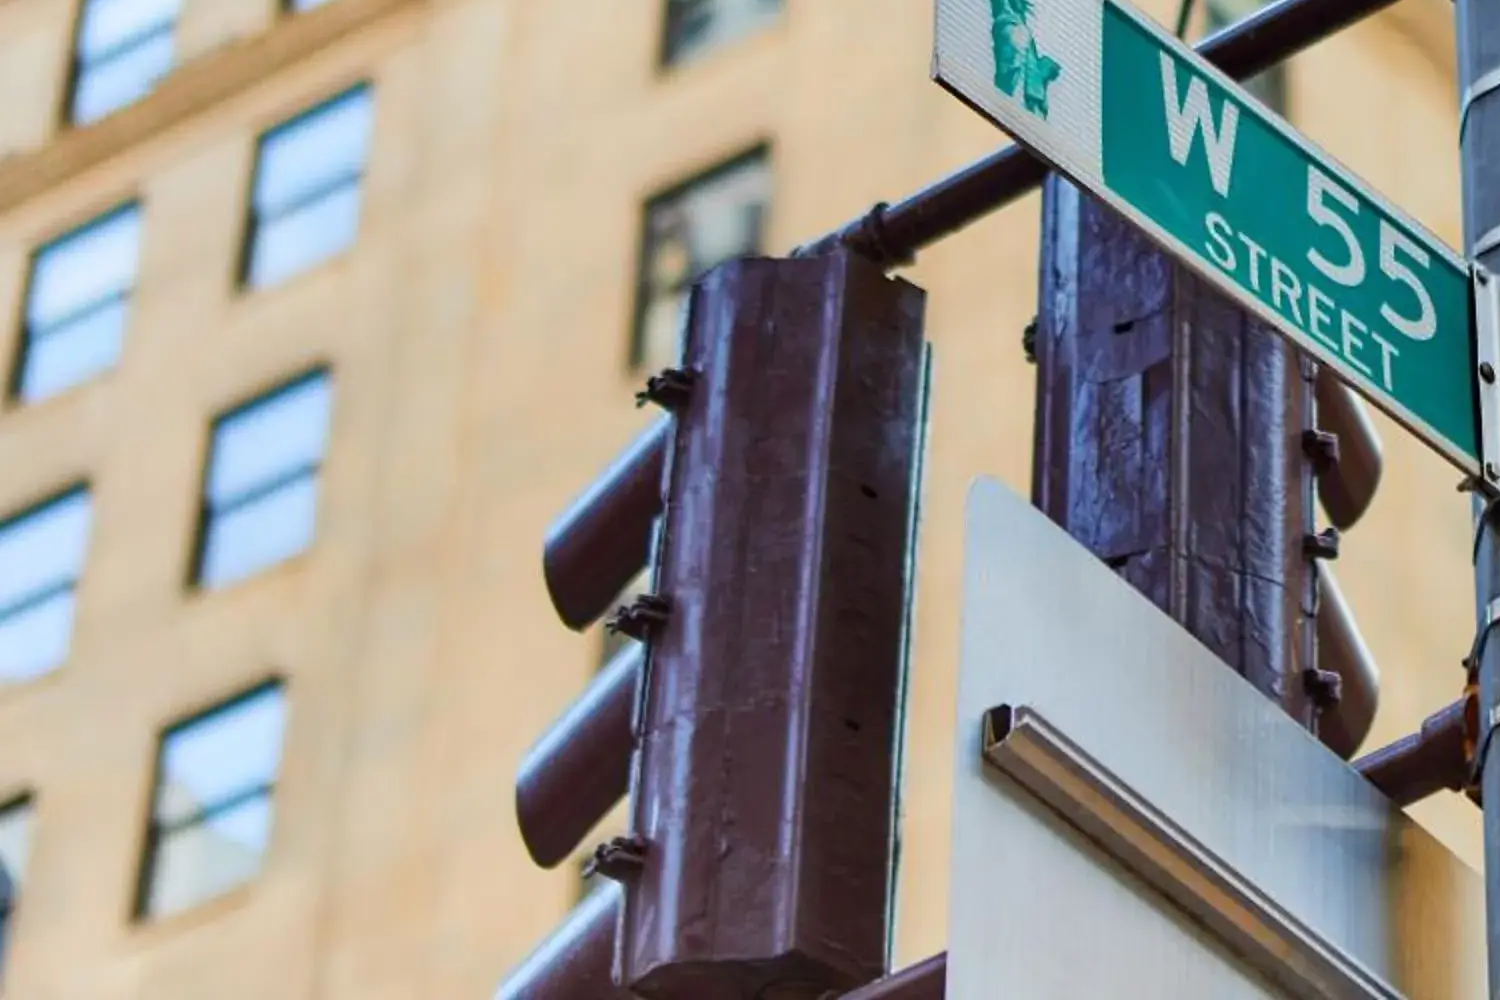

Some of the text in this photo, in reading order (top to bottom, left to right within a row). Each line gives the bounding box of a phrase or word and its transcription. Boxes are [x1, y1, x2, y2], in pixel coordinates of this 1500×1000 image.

[1160, 50, 1437, 341] W 55
[1204, 211, 1399, 392] STREET
